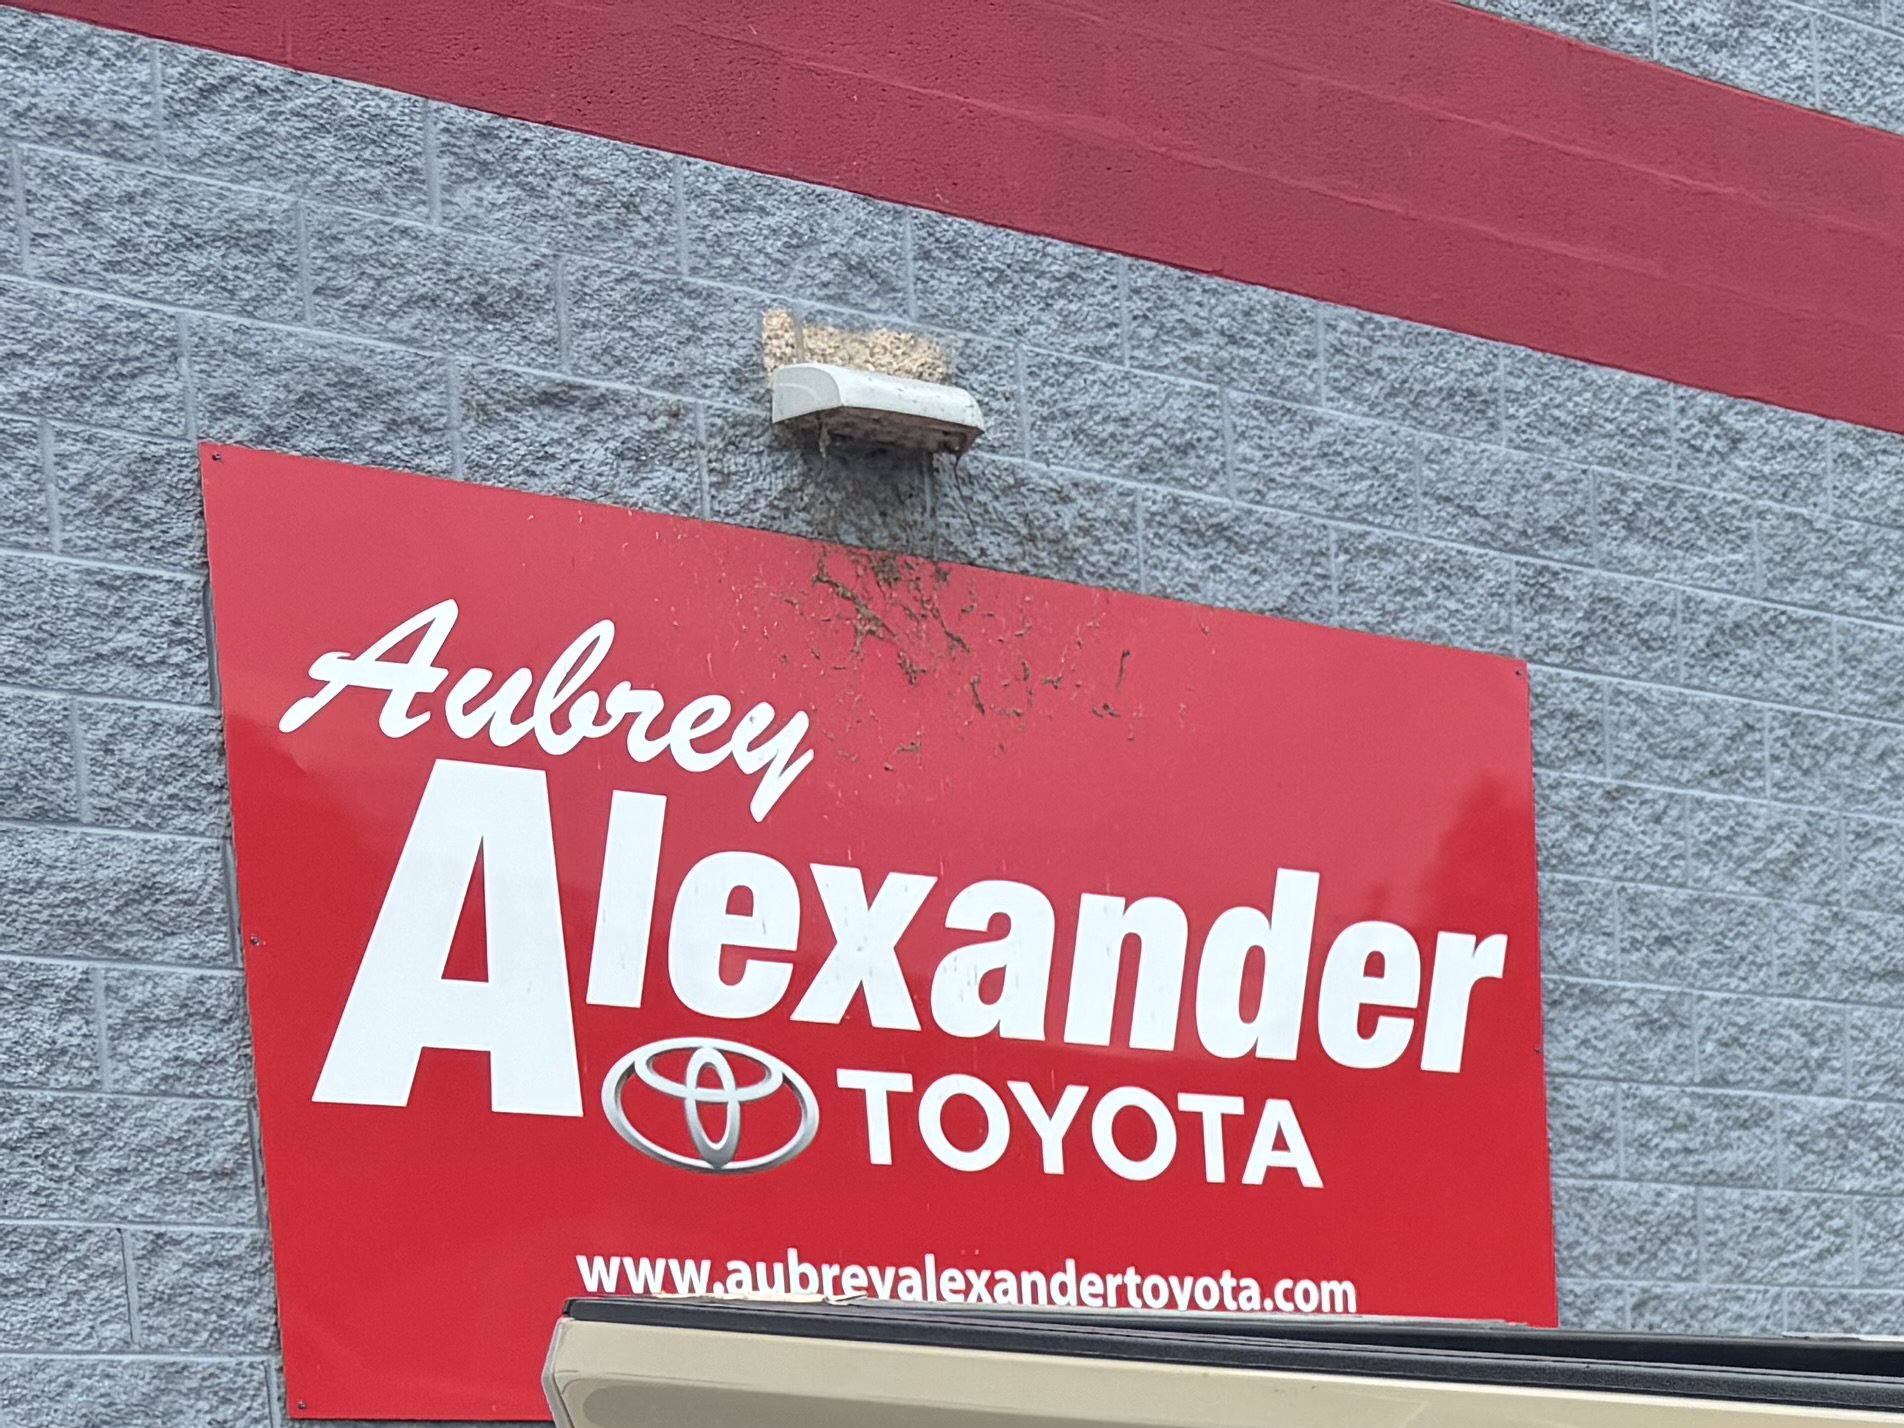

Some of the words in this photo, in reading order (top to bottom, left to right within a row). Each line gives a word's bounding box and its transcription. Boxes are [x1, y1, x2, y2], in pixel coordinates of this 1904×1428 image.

[279, 598, 815, 822] Aubrey
[312, 758, 1508, 1118] Alexander
[836, 1068, 1325, 1189] TOYOTA
[575, 1247, 1358, 1314] www.aubreyalexandertoyota.com
